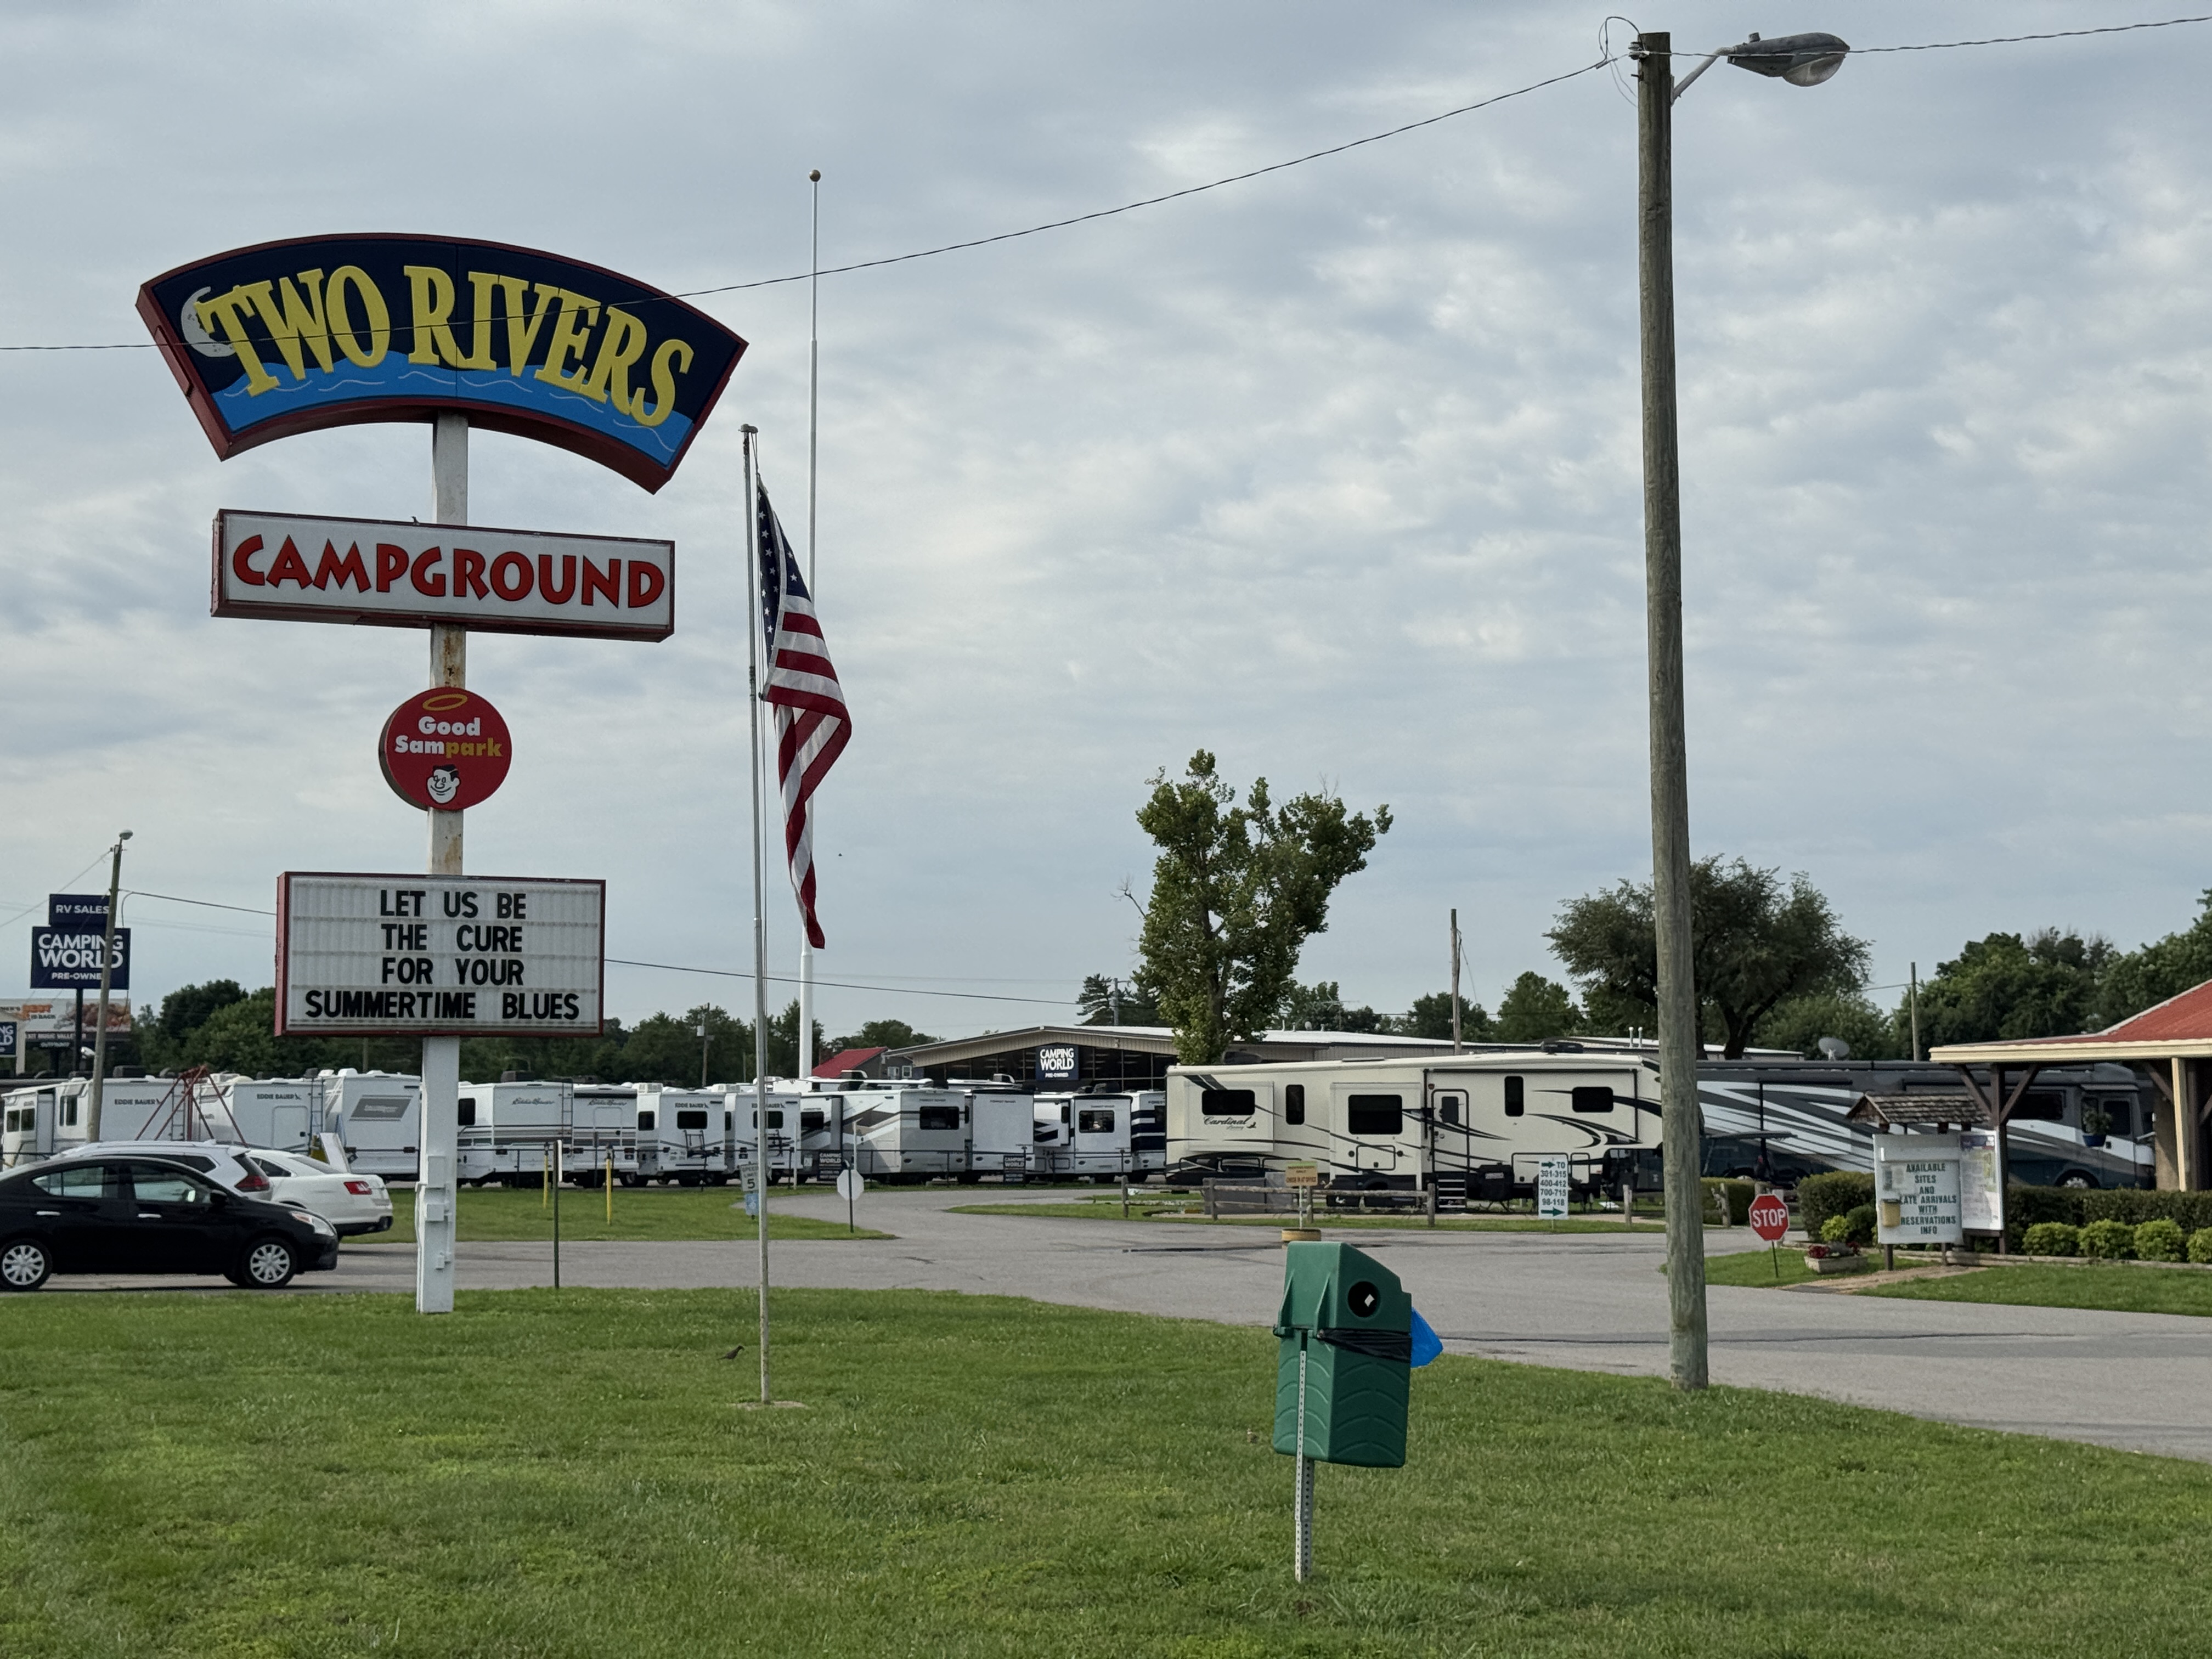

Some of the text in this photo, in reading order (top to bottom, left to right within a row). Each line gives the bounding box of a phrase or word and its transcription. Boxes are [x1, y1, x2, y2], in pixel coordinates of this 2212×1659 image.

[194, 265, 695, 427] TWO RIVERS
[233, 534, 664, 608] CAMPGROUND
[419, 716, 481, 736] Good
[55, 905, 110, 914] RV SALES
[380, 890, 527, 919] LET US BE
[381, 923, 522, 952] THE CURE
[382, 957, 524, 986] FOR YOUR
[306, 990, 580, 1020] SUMMERTIME BLUES
[1040, 1048, 1074, 1059] CAMPING
[1040, 1058, 1074, 1070] WORLD
[1204, 1116, 1252, 1125] Cardinal
[1906, 1163, 1945, 1172] AVAILABLE
[747, 1178, 755, 1189] 5
[1915, 1175, 1936, 1183] SITES
[1919, 1186, 1935, 1195] AND
[1921, 1195, 1957, 1204] ARRIVALS
[1918, 1205, 1938, 1214] WITH
[1752, 1208, 1786, 1228] STOP
[1900, 1216, 1956, 1225] RESERVATIONS
[1920, 1226, 1938, 1234] INFO
